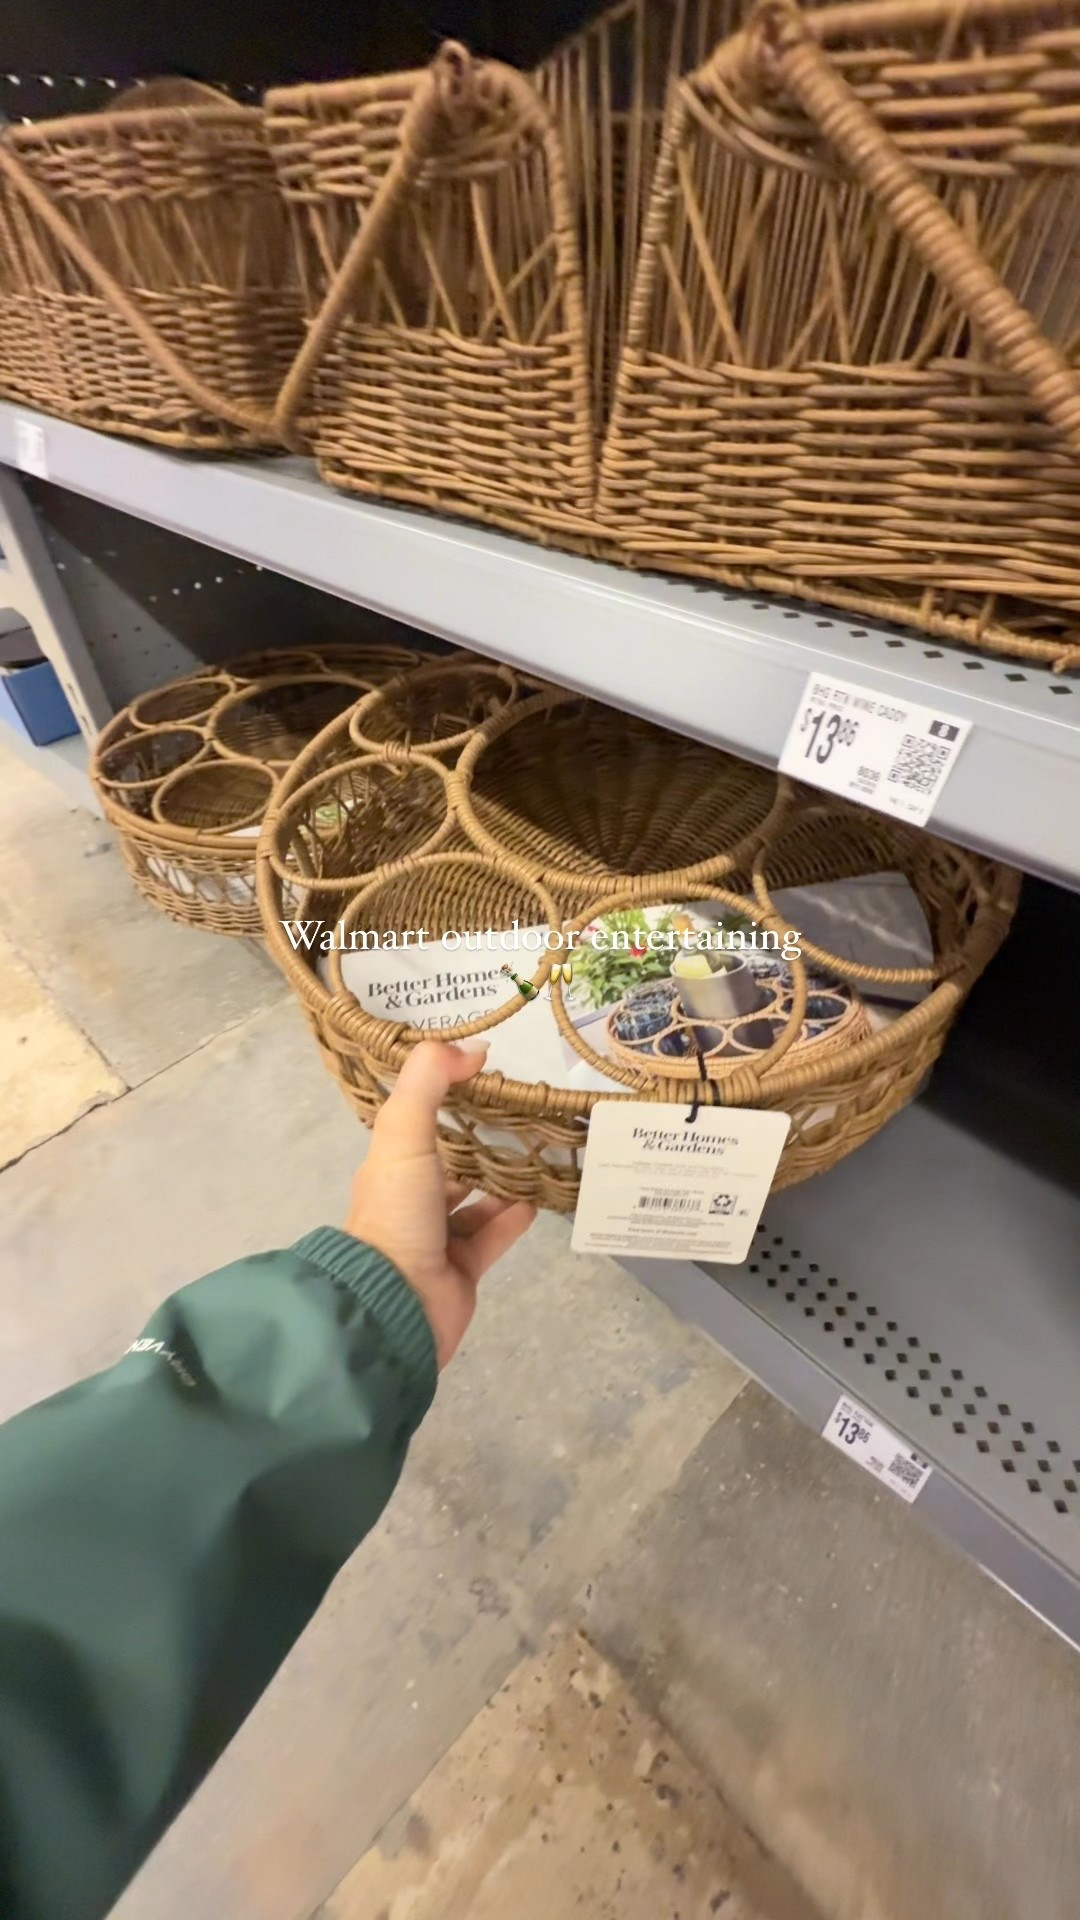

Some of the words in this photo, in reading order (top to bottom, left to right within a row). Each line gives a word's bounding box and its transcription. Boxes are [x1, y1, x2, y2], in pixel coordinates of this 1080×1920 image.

[852, 695, 877, 714] WINE
[368, 977, 432, 998] Better
[385, 994, 402, 1011] &
[405, 984, 498, 1008] Gardens
[632, 1127, 681, 1141] Better
[683, 1131, 739, 1146] Homes
[657, 1140, 725, 1156] Gardens
